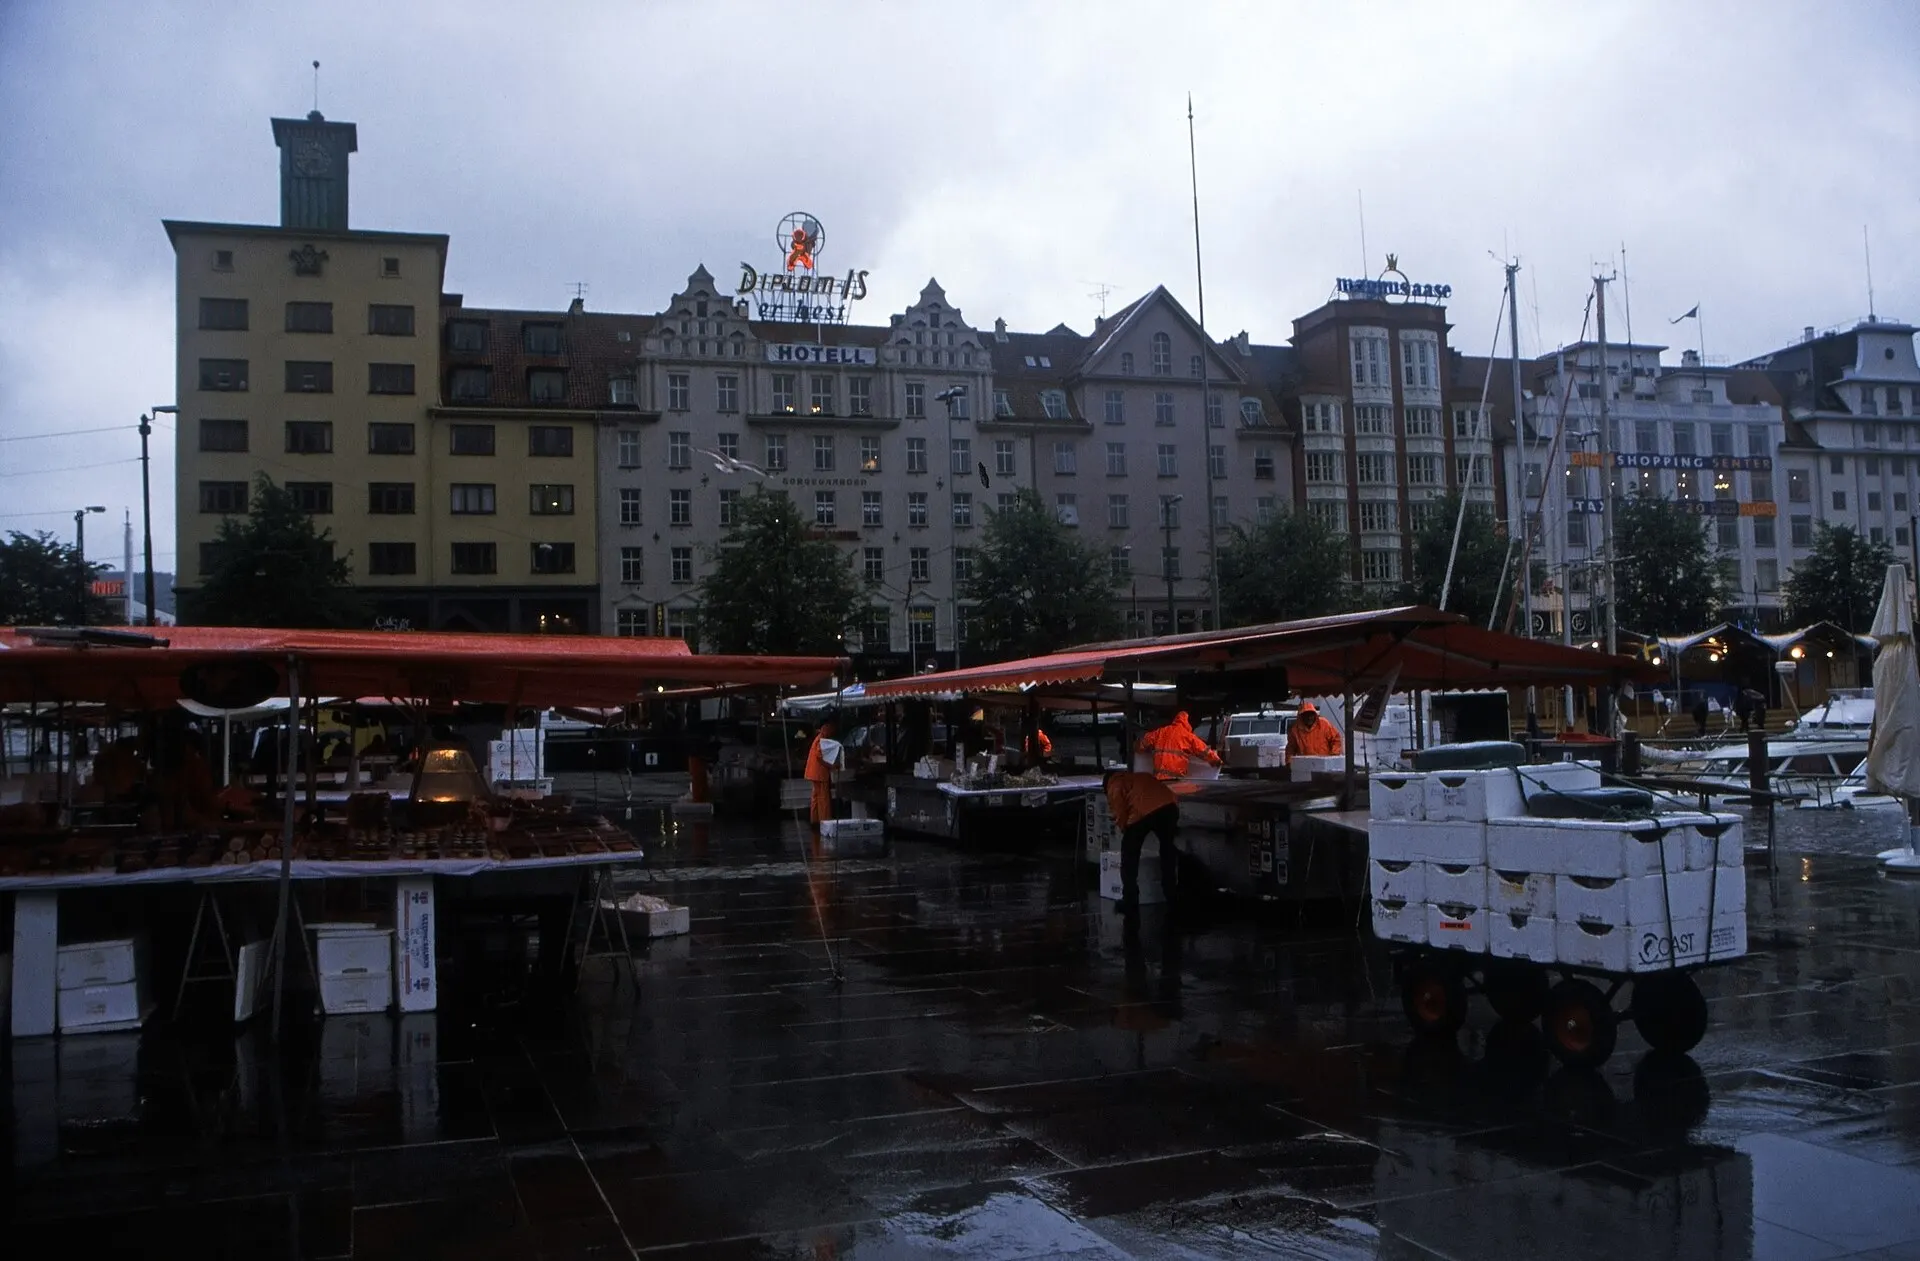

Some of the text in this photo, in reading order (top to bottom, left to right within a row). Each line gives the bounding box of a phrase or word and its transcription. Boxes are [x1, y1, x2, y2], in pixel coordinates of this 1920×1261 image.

[778, 345, 866, 363] HOTELL
[1616, 454, 1704, 468] SHOPPING
[1711, 457, 1771, 470] SENTER
